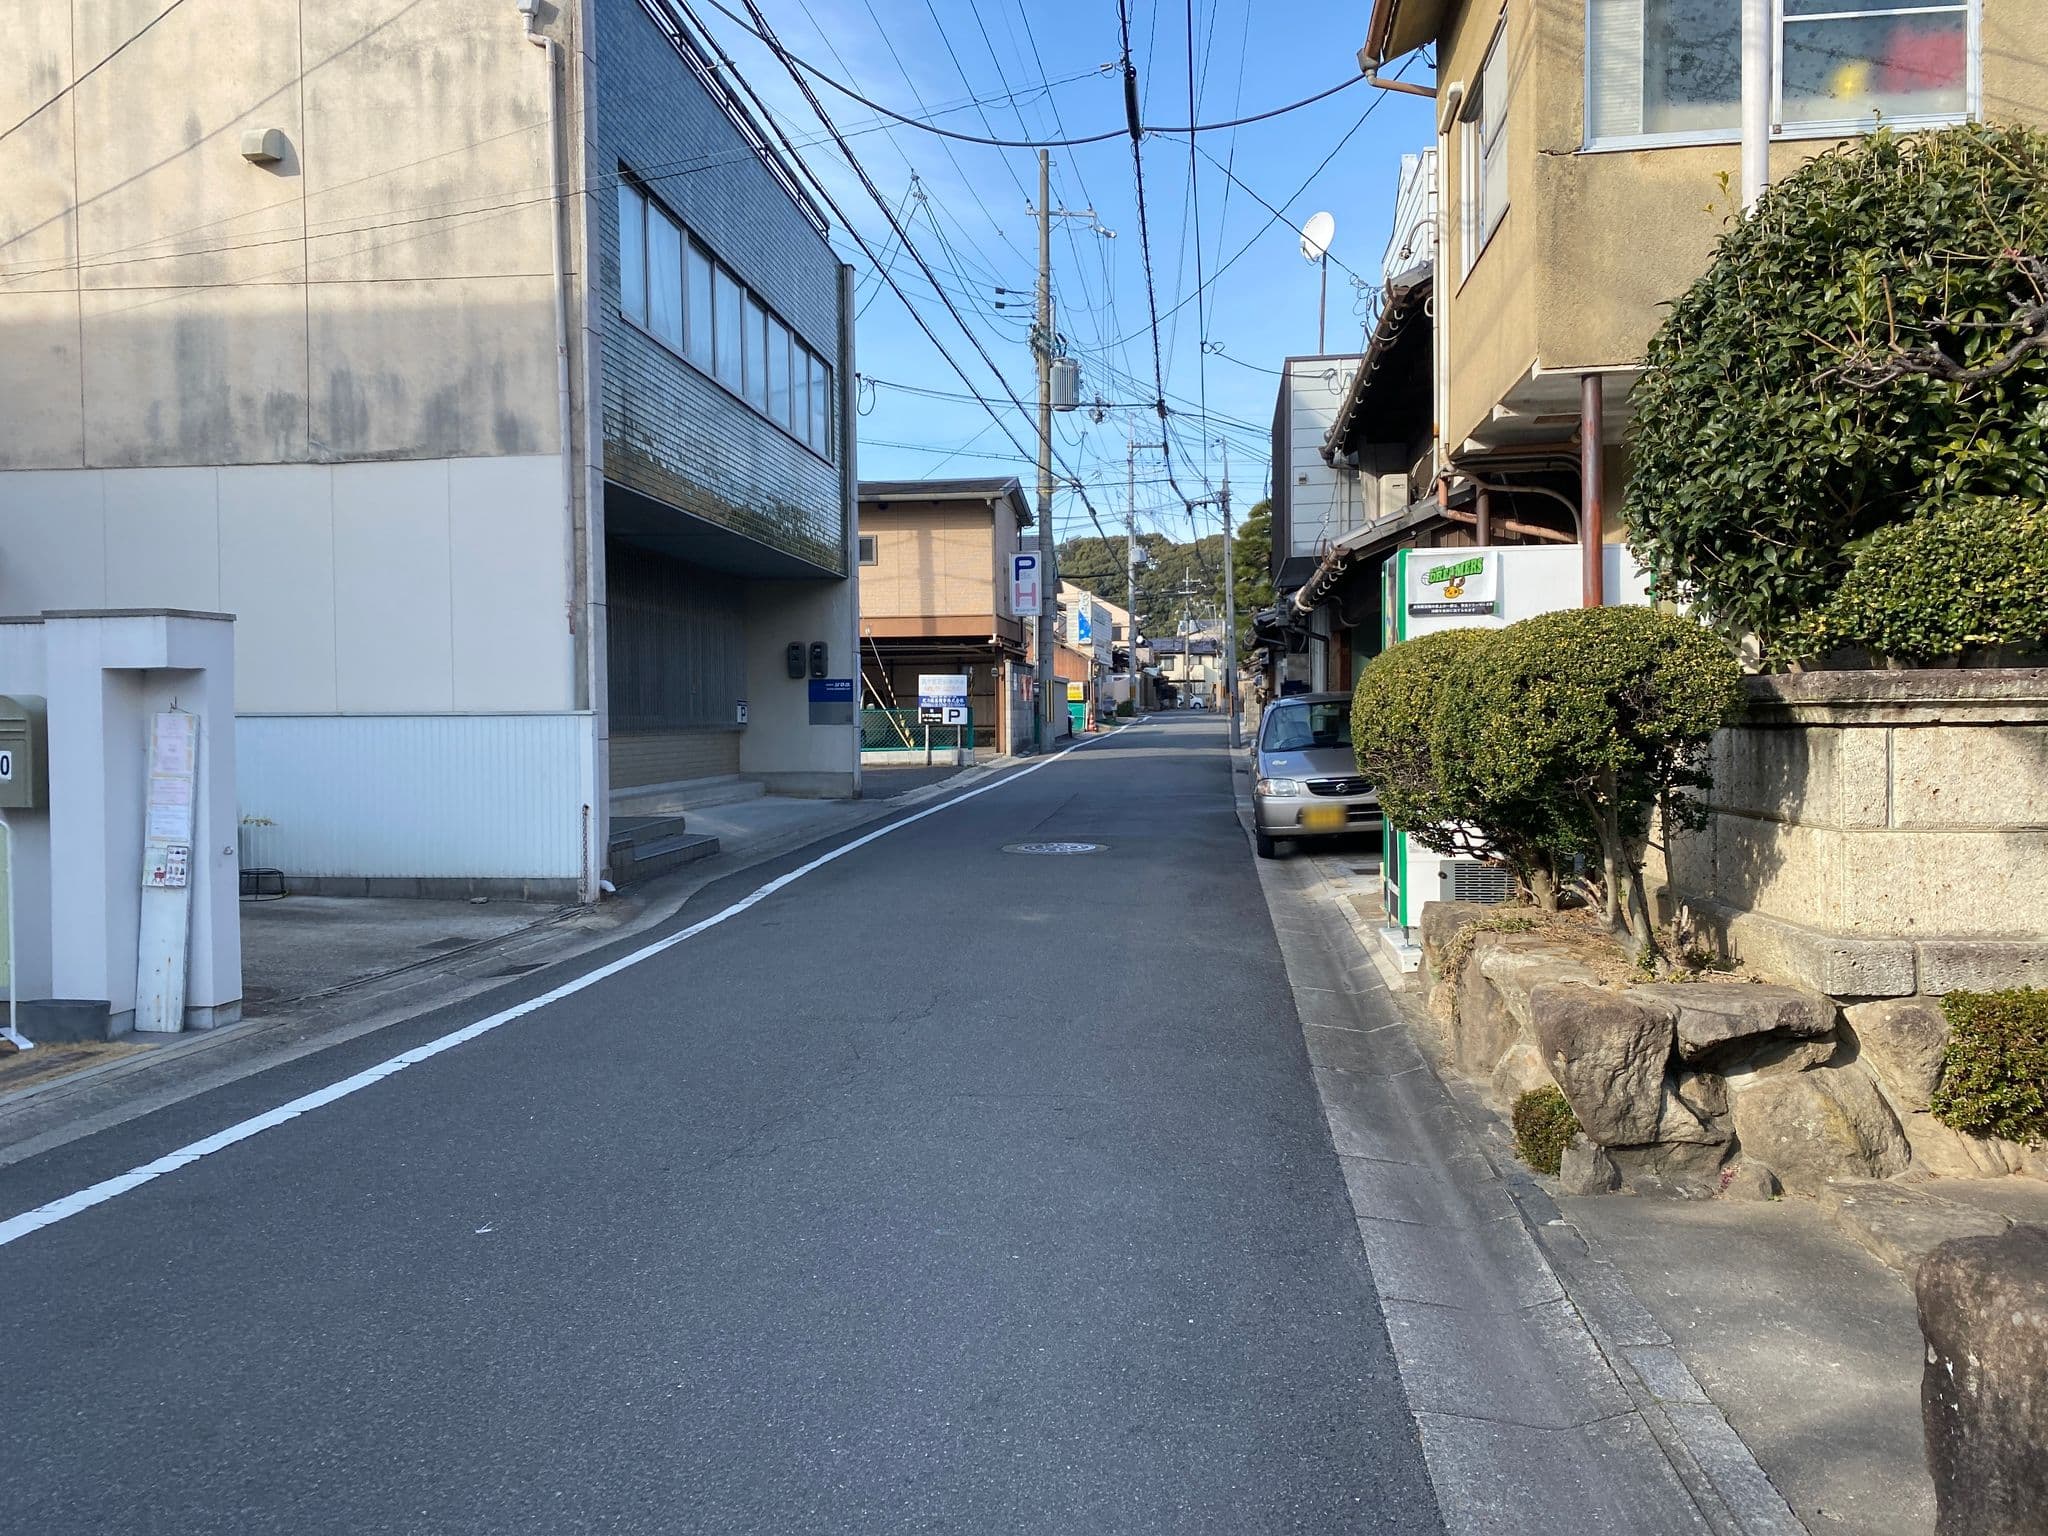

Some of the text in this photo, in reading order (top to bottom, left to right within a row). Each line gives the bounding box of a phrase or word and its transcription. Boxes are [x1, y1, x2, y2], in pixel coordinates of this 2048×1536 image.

[1015, 556, 1036, 581] P
[1429, 557, 1484, 583] DREAMERS
[948, 709, 960, 722] P
[0, 755, 10, 776] 0
